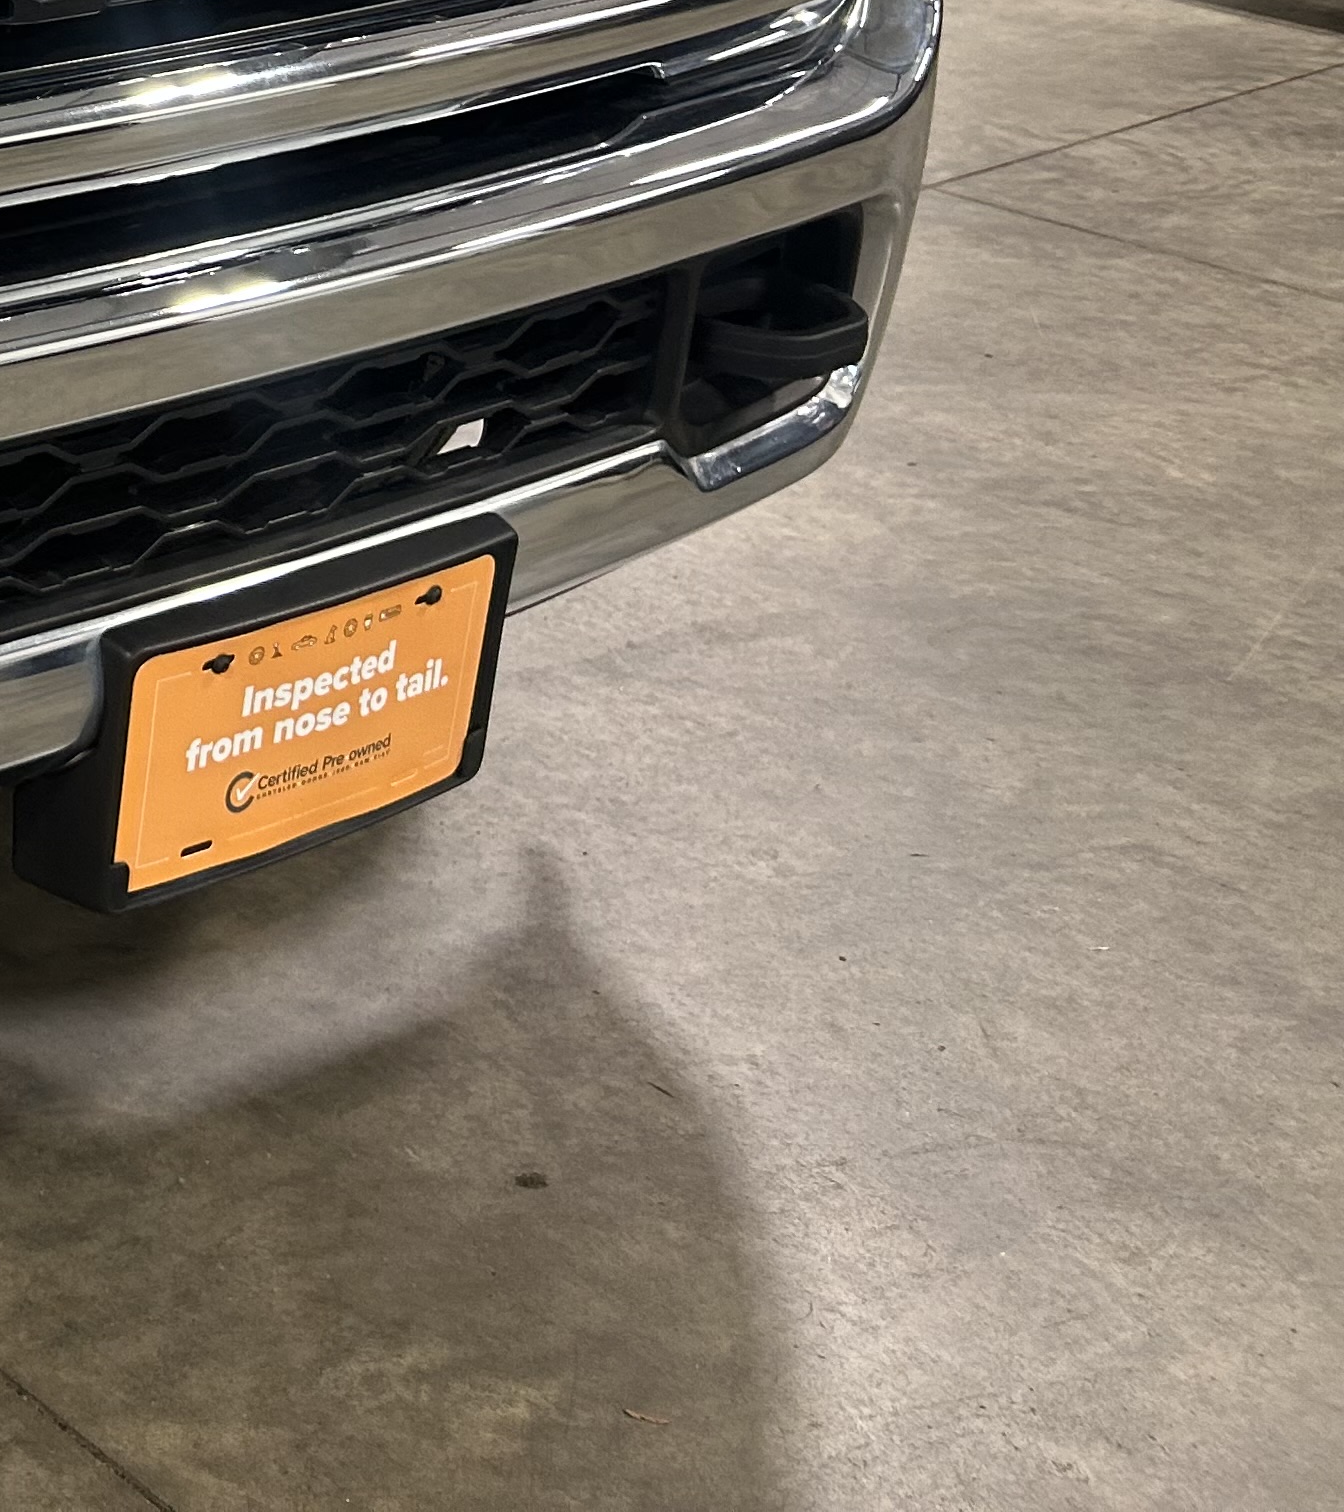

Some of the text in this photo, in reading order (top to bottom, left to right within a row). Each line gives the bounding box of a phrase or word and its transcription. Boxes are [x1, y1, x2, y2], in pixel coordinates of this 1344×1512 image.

[185, 658, 449, 772] from nose to tail.
[242, 639, 397, 717] Inspected
[257, 759, 318, 791] Certified
